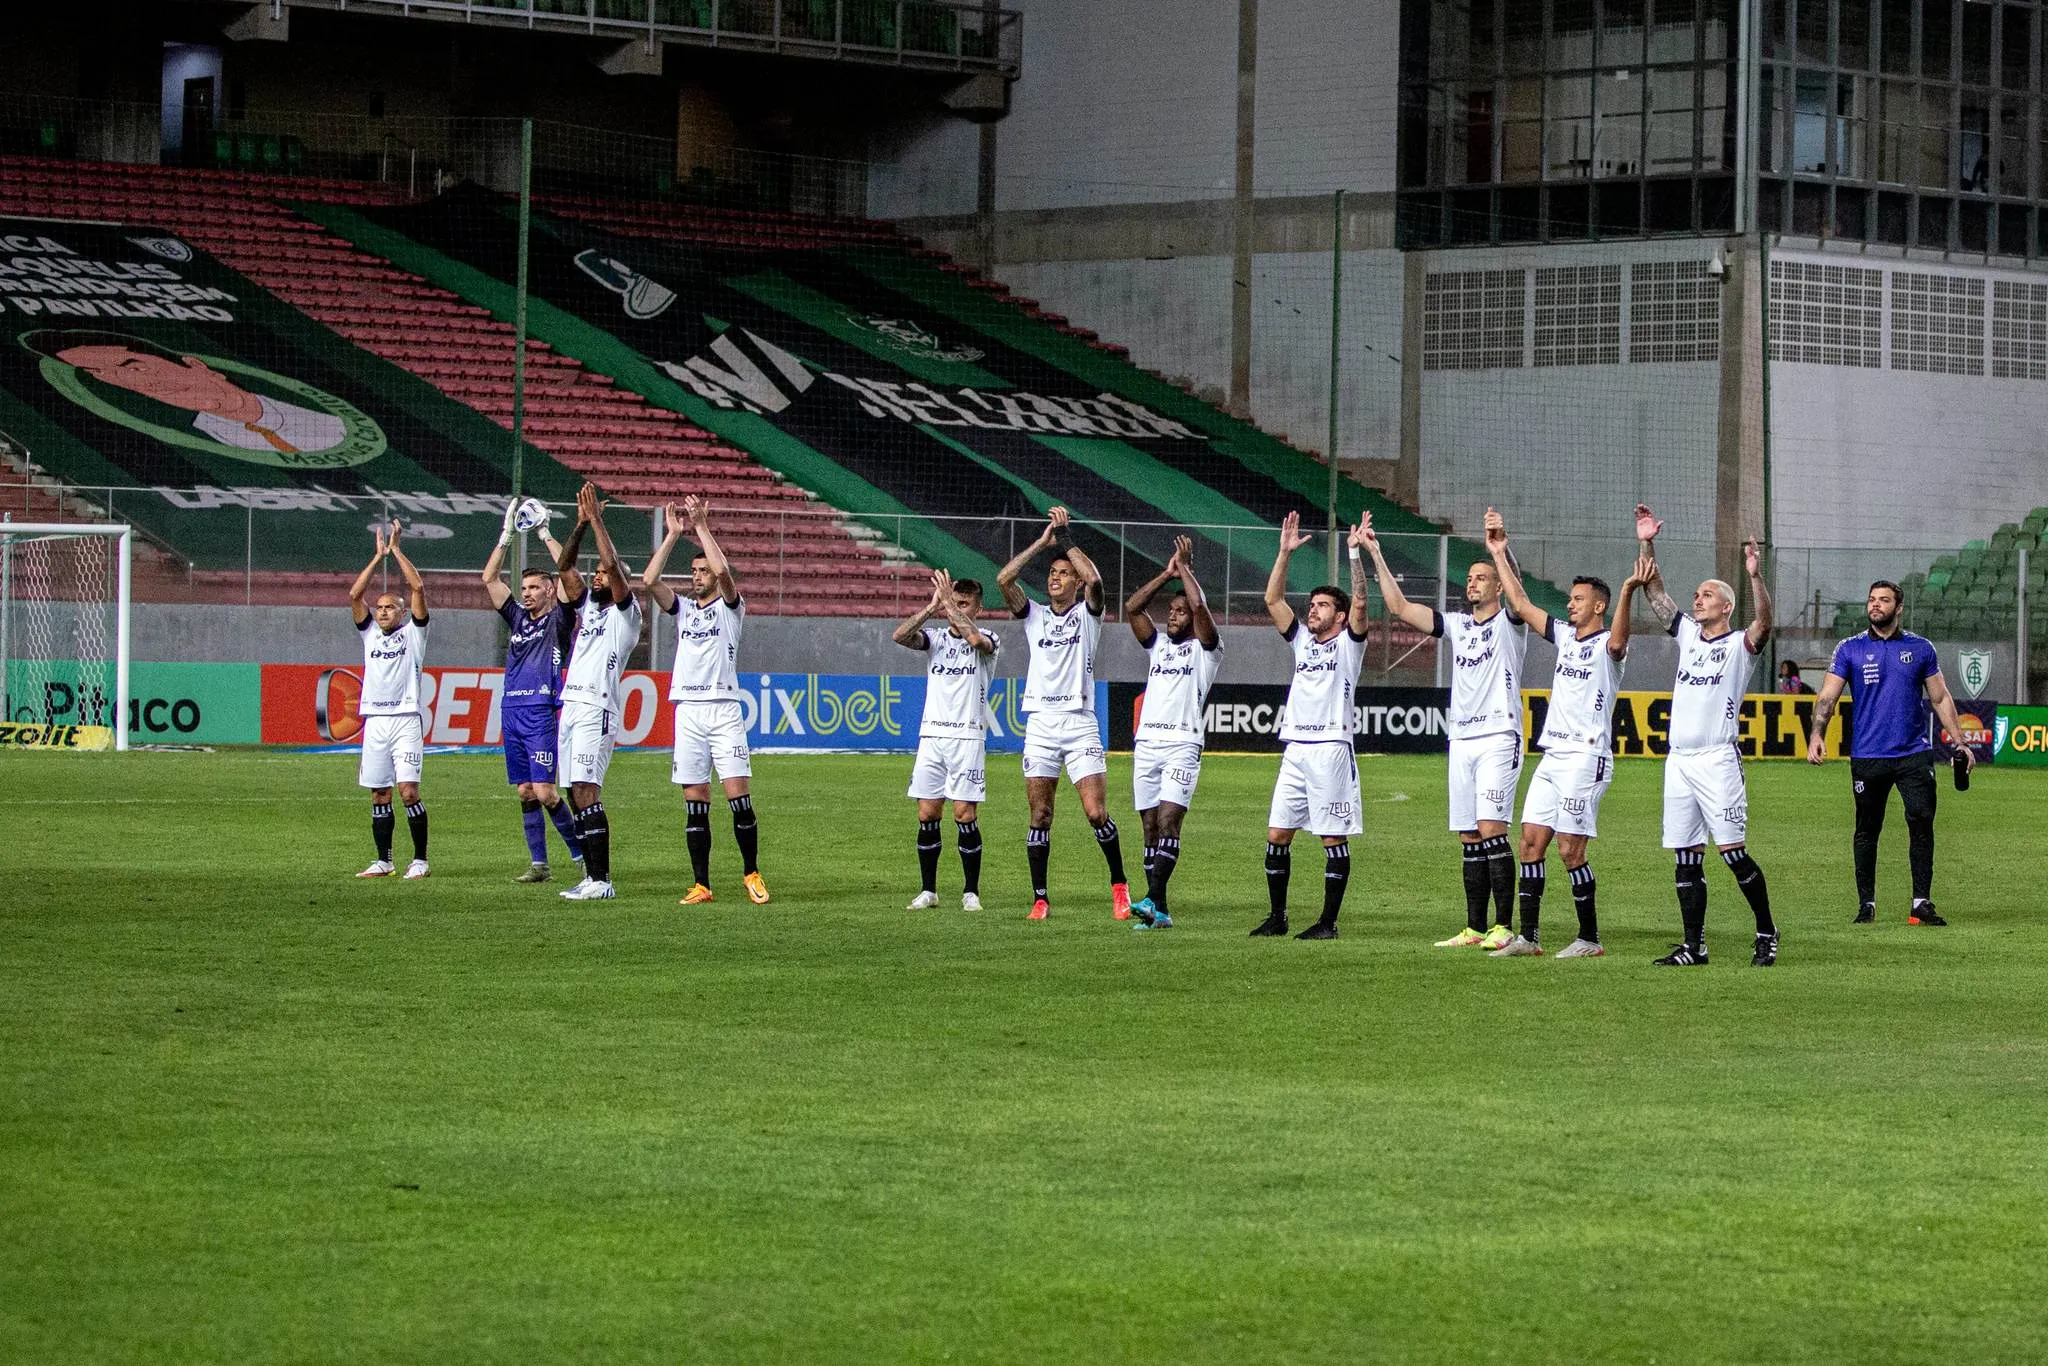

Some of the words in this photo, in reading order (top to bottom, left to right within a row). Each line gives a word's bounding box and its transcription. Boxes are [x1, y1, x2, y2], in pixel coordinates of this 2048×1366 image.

[7, 296, 233, 322] PAVILHÃO
[945, 664, 977, 676] zenir
[1562, 667, 1592, 680] zenir
[1689, 672, 1724, 686] zenir
[45, 681, 200, 733] Pitaco
[1202, 703, 1288, 734] MERCA
[1353, 706, 1453, 736] BITCOIN
[2011, 725, 2048, 752] OFI
[535, 752, 553, 764] ZELO
[577, 754, 595, 763] ZELO
[732, 746, 748, 758] ZEL
[1171, 768, 1192, 782] ZELO
[1486, 790, 1504, 800] ZELO
[1329, 802, 1350, 815] ZELO
[1563, 798, 1585, 812] ZELO
[1724, 807, 1743, 820] ZELO
